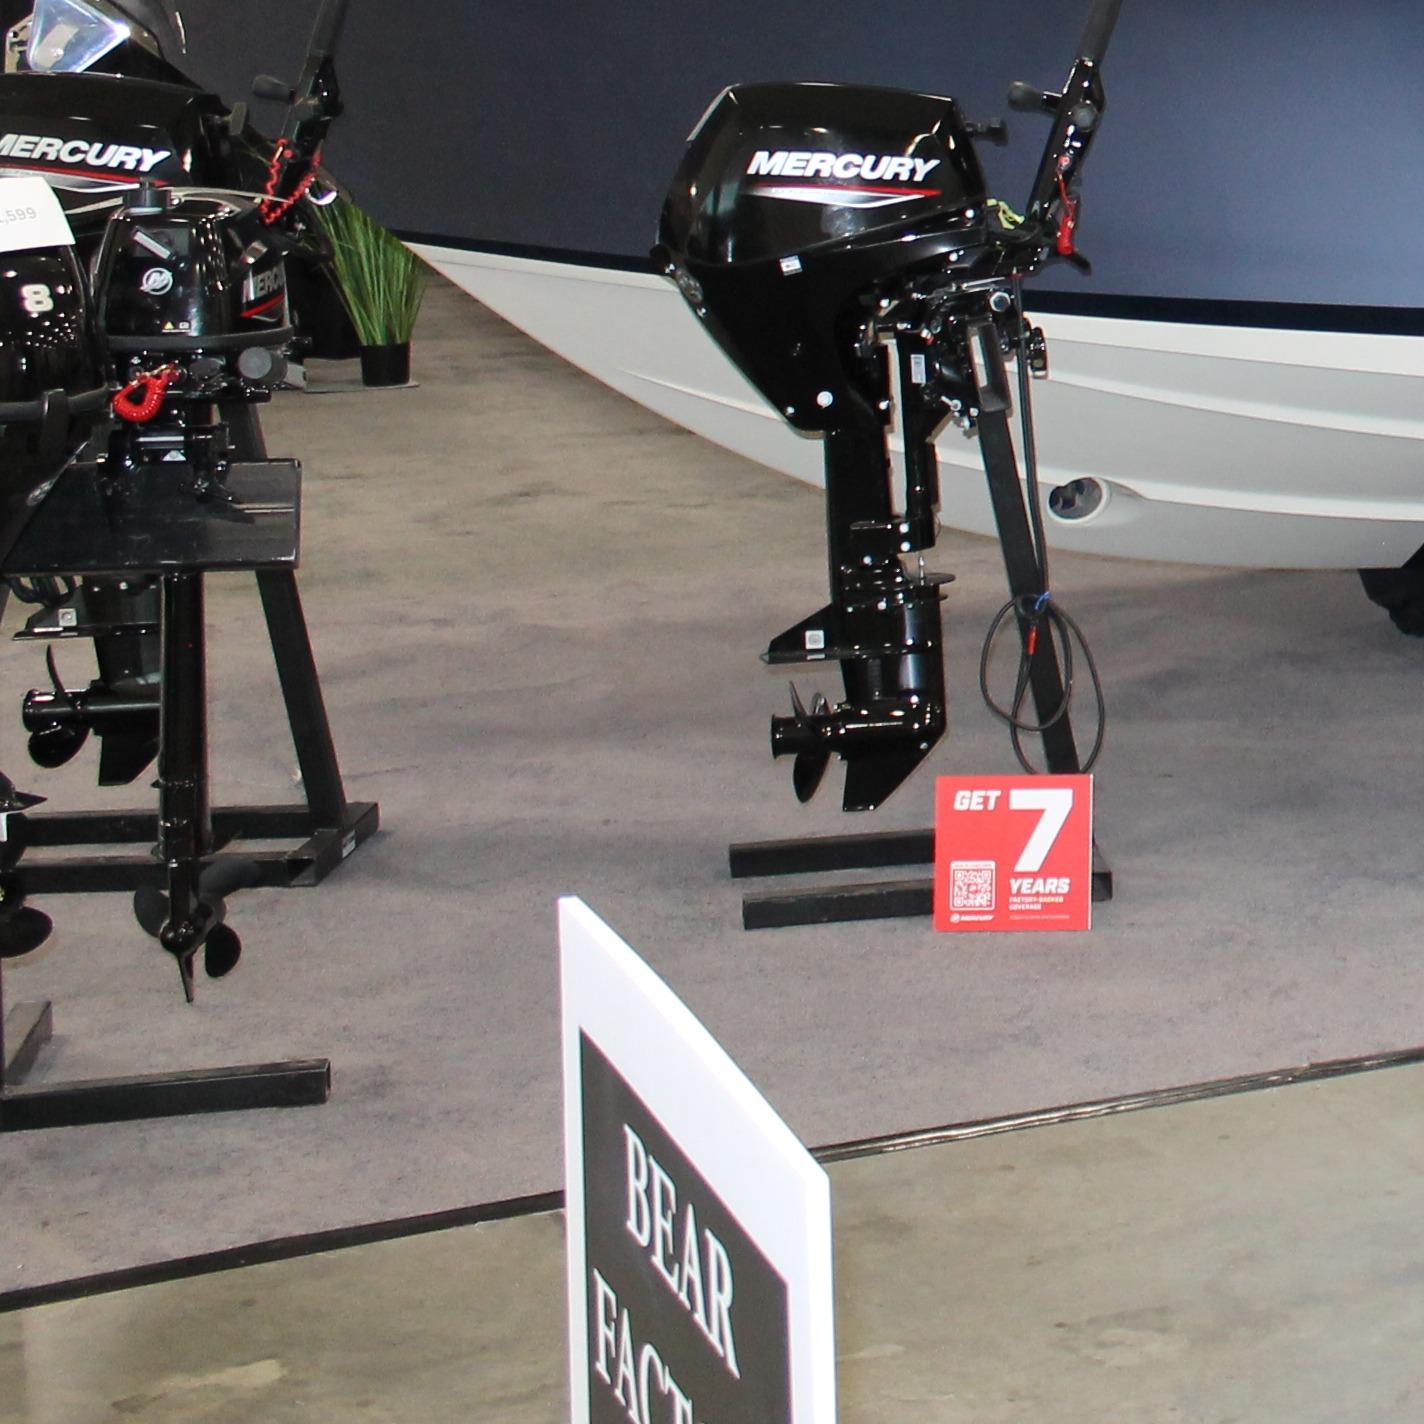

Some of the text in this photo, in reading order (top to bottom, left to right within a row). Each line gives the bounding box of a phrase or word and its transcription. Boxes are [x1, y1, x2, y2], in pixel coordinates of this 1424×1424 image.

[746, 150, 941, 183] MERCURY
[0, 206, 37, 225] ,599
[953, 788, 1074, 873] GET 7
[1008, 877, 1071, 895] YEARS
[622, 1122, 741, 1380] BEAR
[593, 1267, 704, 1424] FACT
